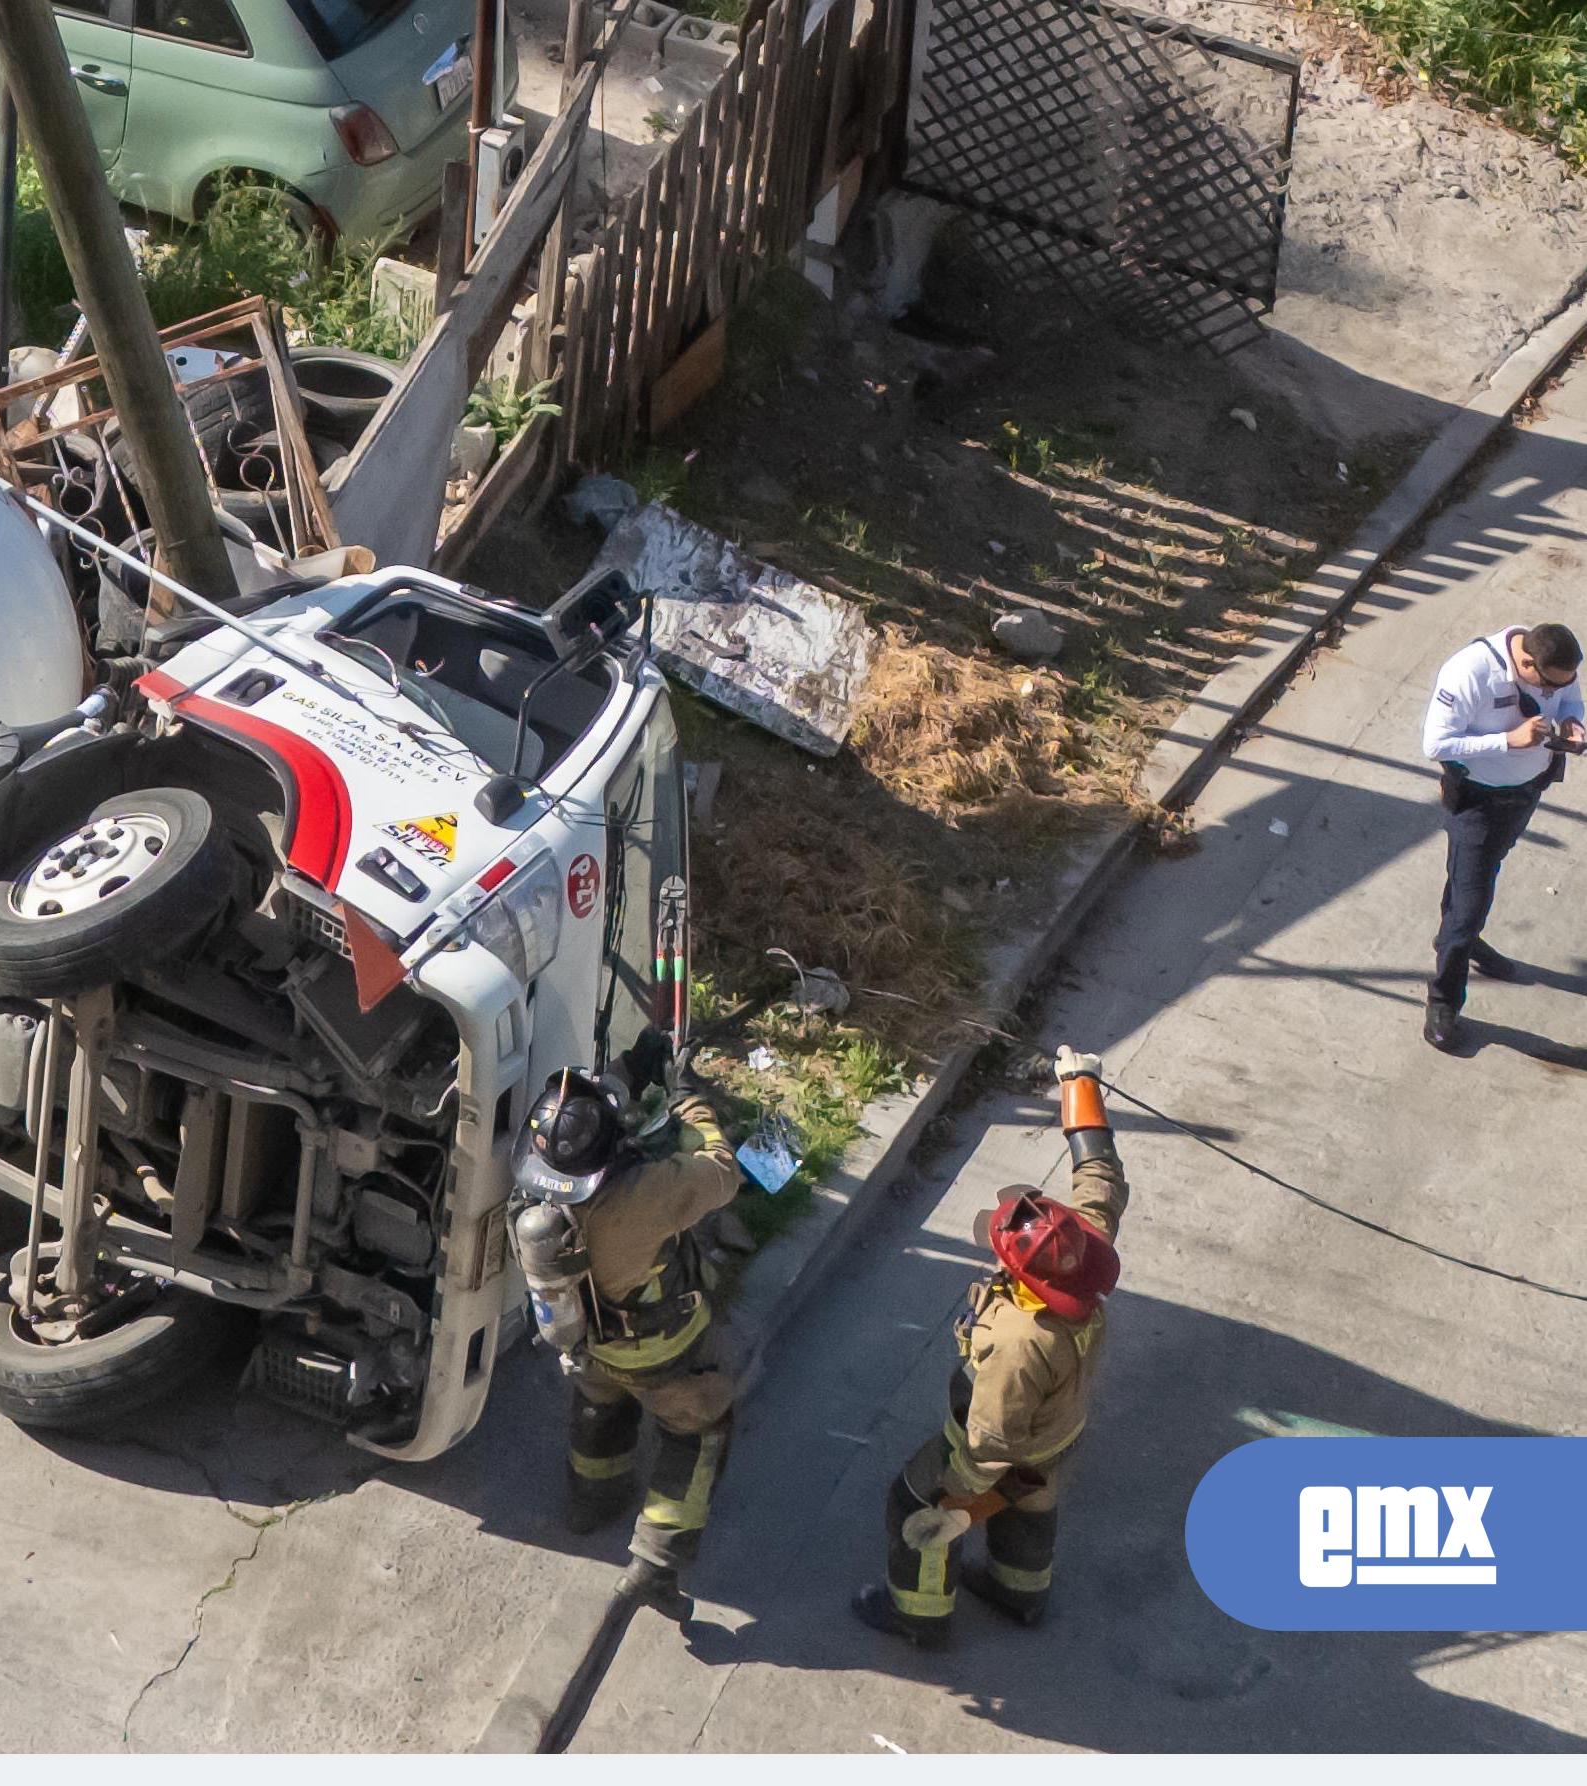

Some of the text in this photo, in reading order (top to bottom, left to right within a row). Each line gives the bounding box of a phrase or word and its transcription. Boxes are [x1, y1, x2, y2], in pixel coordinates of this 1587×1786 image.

[282, 691, 317, 710] GAS
[411, 750, 436, 766] DE
[437, 762, 468, 785] C.V.
[381, 824, 452, 867] SILZA
